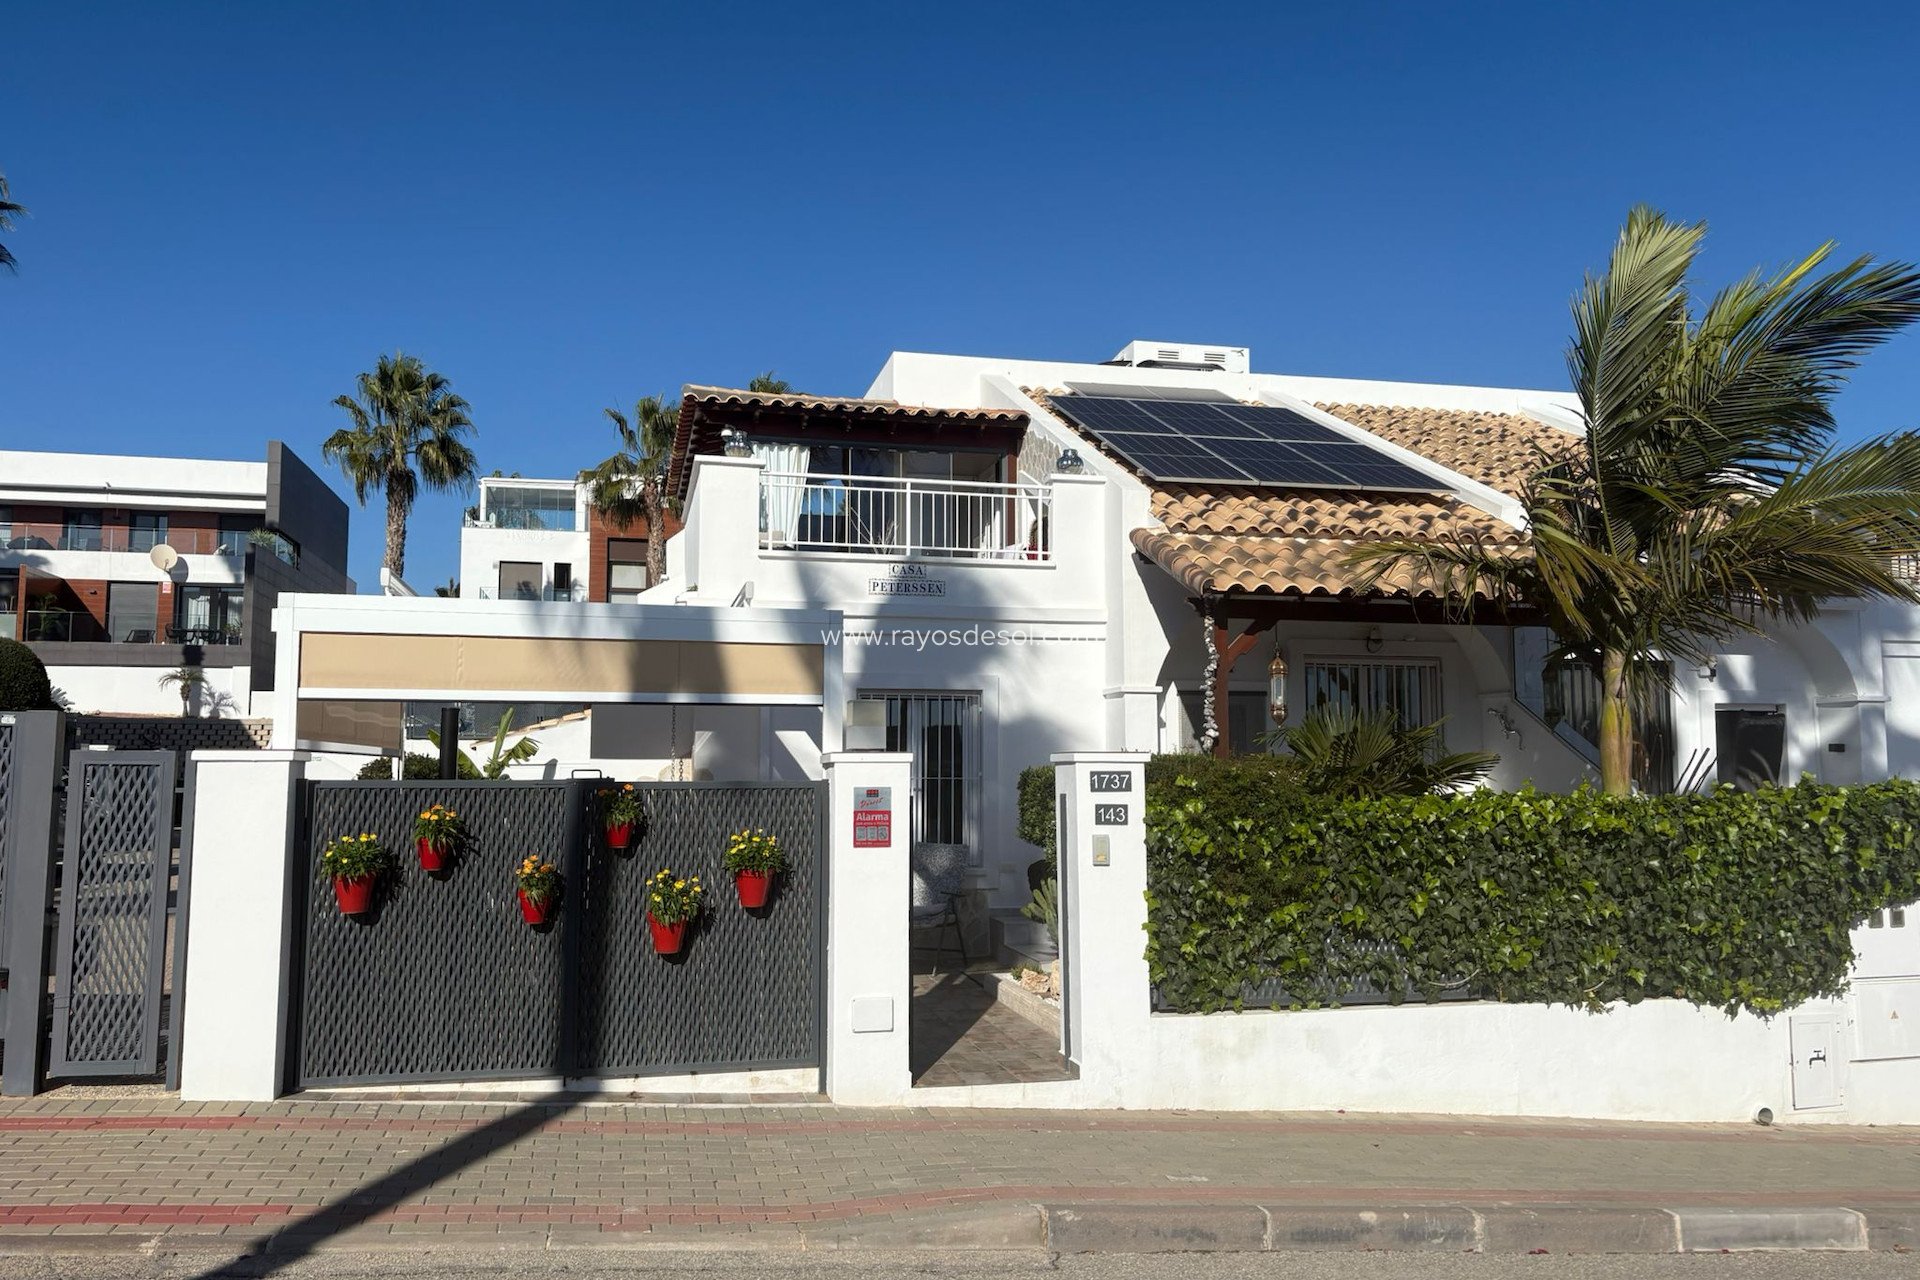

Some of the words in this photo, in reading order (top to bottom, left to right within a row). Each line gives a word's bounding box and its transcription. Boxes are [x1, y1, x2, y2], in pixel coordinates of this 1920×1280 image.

[892, 564, 923, 575] CASA
[872, 581, 943, 594] PETERSSEN
[1091, 774, 1130, 789] 1737
[856, 812, 889, 821] Alarma
[1098, 807, 1126, 822] 143
